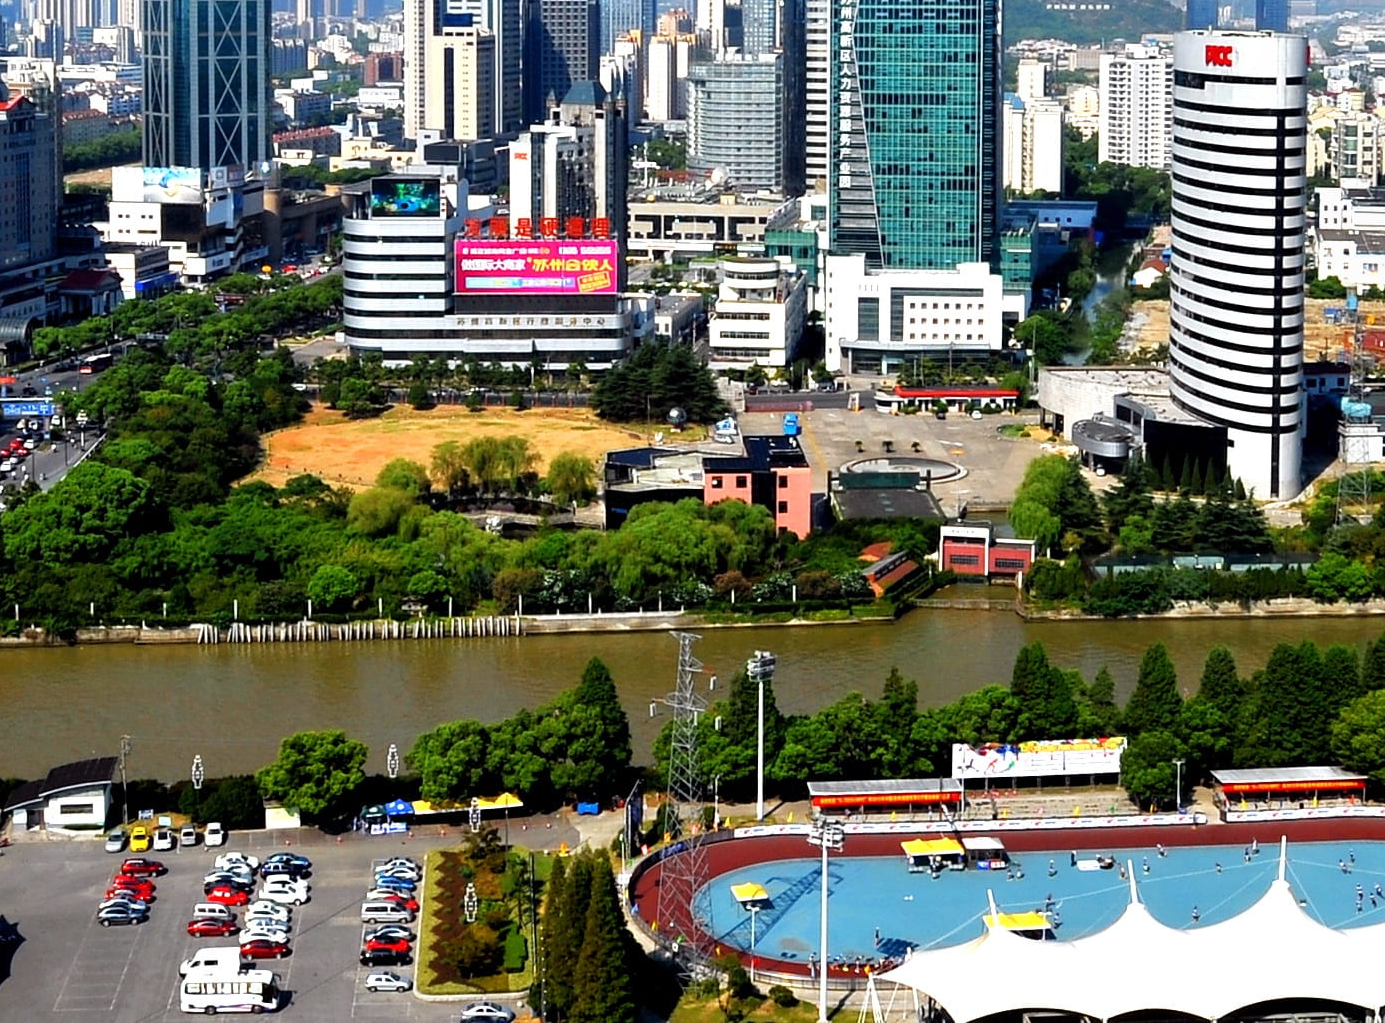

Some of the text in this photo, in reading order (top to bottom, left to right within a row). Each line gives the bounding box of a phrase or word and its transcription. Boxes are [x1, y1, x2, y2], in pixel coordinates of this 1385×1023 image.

[1205, 44, 1233, 67] PICC
[463, 217, 611, 238] 发展是硬道理
